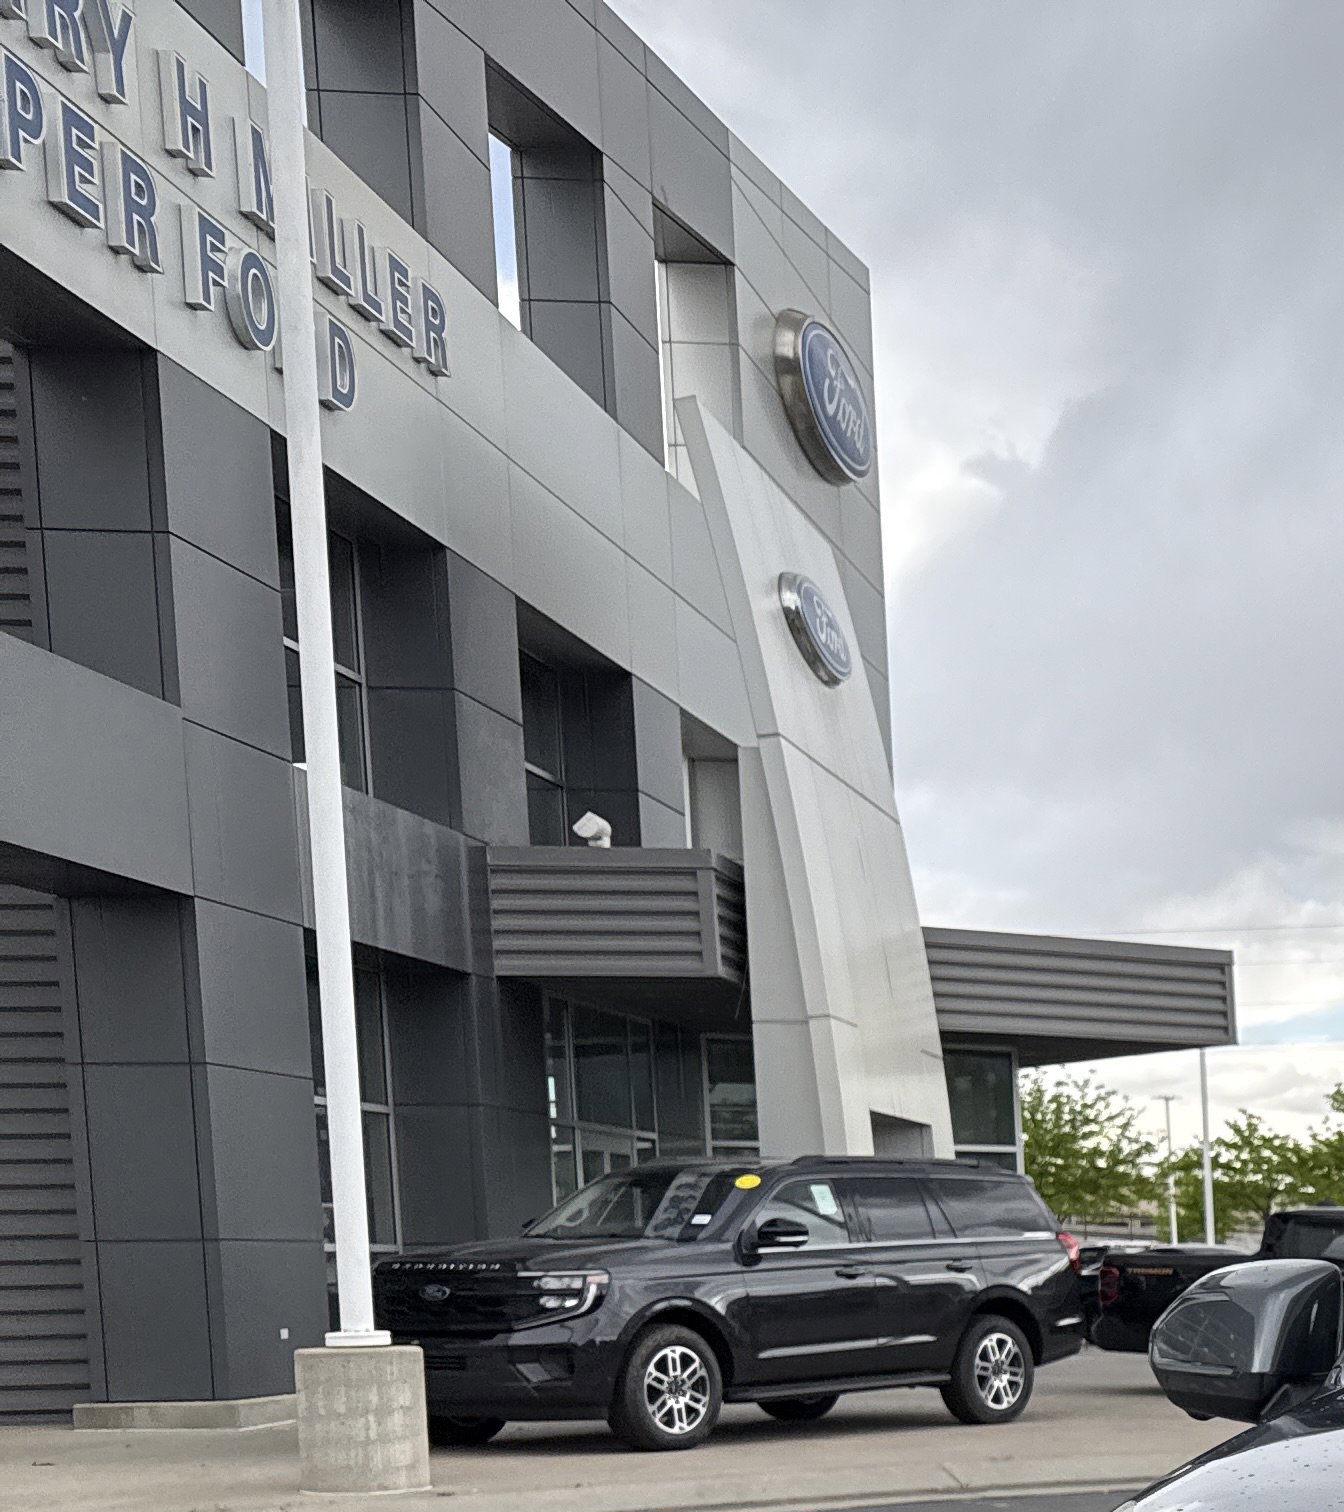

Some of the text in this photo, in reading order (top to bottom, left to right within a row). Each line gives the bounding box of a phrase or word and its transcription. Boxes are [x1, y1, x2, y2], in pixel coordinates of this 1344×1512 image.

[168, 49, 215, 178] H
[246, 119, 451, 378] MLLER
[192, 205, 358, 412] FOD
[823, 347, 866, 457] Ford
